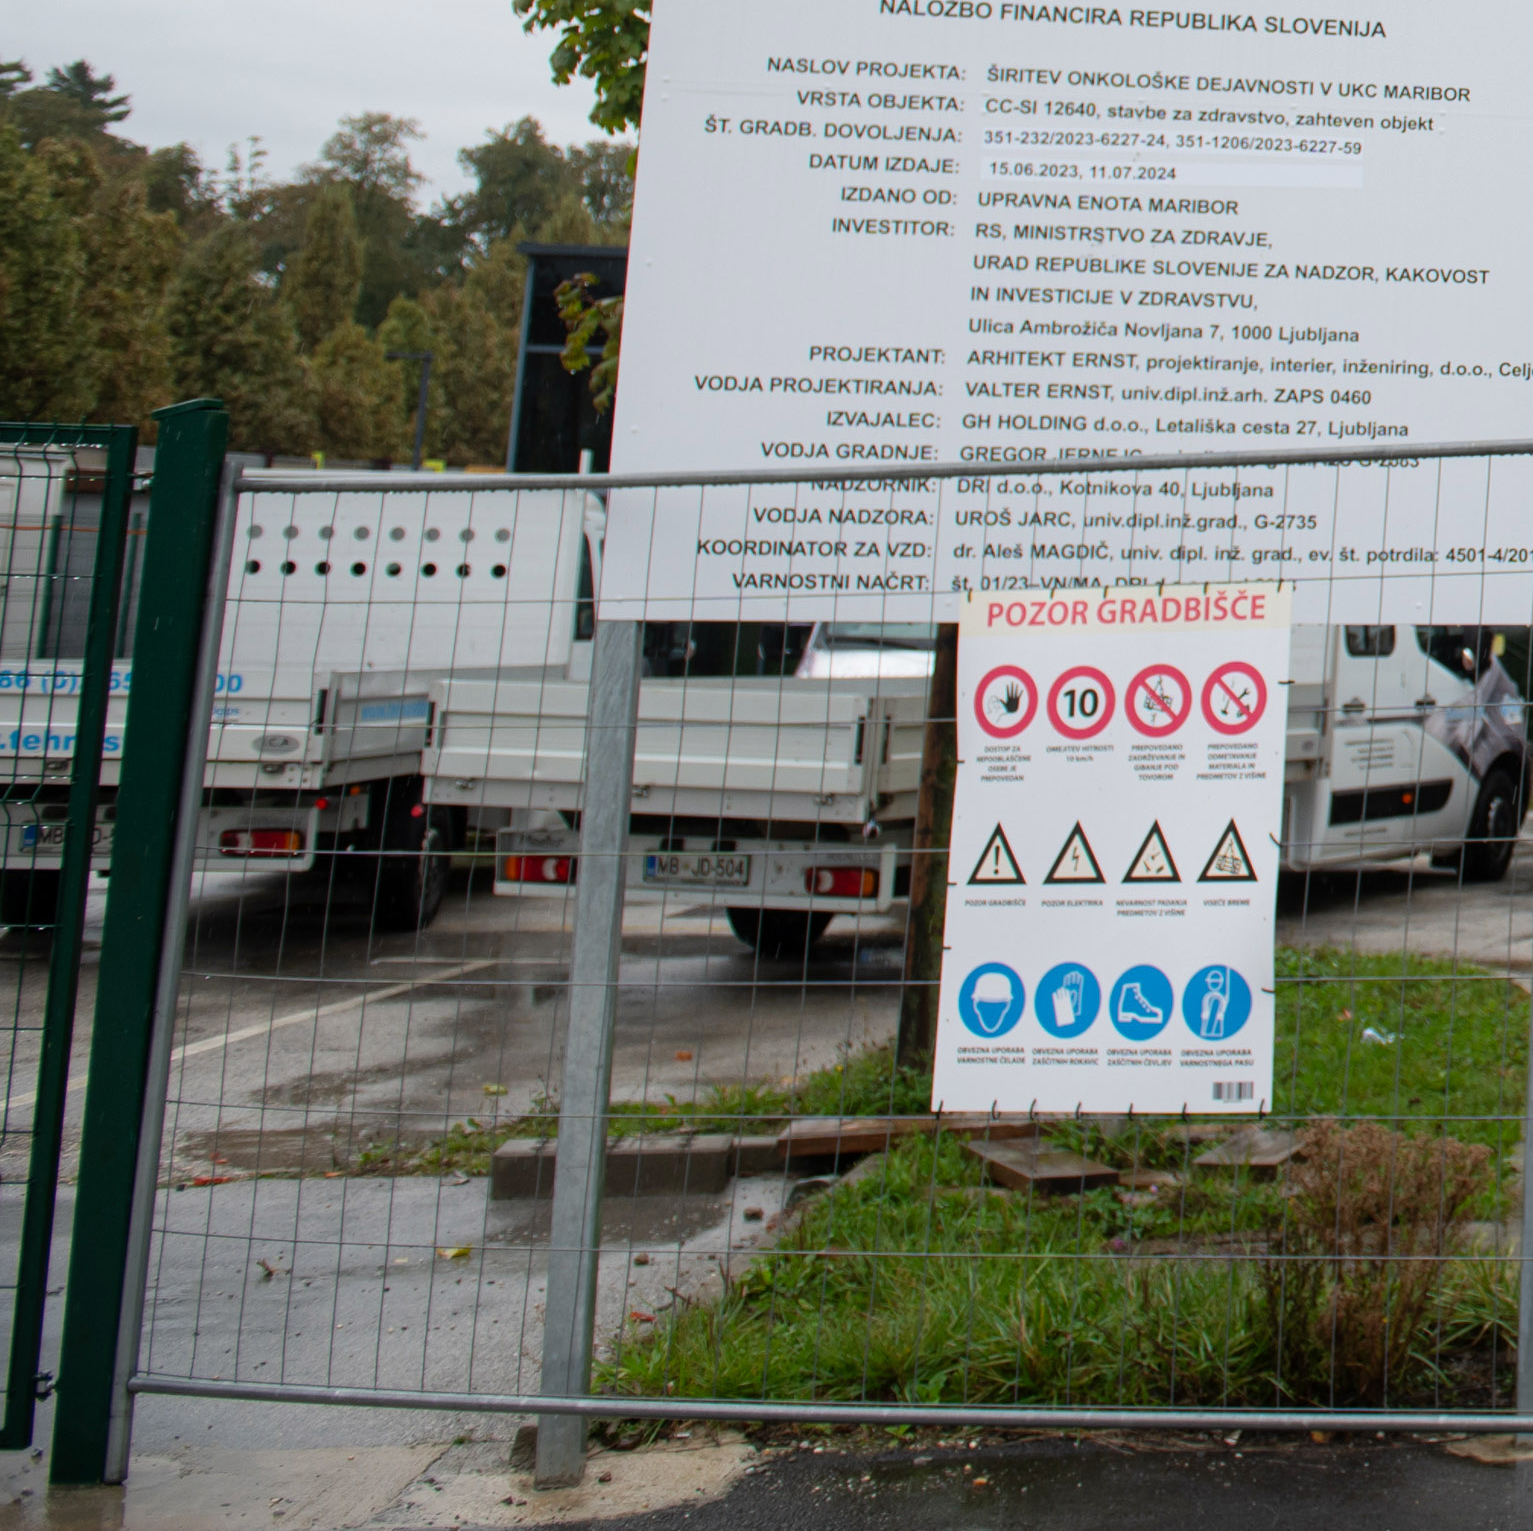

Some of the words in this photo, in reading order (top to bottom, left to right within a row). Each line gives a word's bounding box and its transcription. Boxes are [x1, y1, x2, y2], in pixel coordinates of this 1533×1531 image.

[999, 3, 1122, 25] FINANCIRA
[1128, 9, 1257, 32] REPUBLIKA
[1263, 15, 1386, 38] SLOVENIJA
[766, 57, 850, 75] NASLOV
[854, 61, 965, 80] PROJEKTA:
[986, 63, 1062, 85] ŠIRITEV
[1066, 70, 1189, 90] ONKOLOŠKE
[1195, 76, 1314, 95] DEJAVNOSTI
[1319, 81, 1332, 96] V
[1337, 82, 1377, 98] UKC
[1383, 84, 1470, 102] MARIBOR
[796, 90, 861, 107] VRSTA
[866, 93, 964, 111] OBJEKTA:
[984, 97, 1037, 114] CC-SI
[1044, 101, 1100, 119] 12640,
[1106, 105, 1167, 120] stavbe
[1171, 109, 1192, 121] za
[1197, 107, 1289, 126] zdravstvo,
[1295, 112, 1374, 128] zahteven
[1379, 115, 1434, 134] objekt
[703, 114, 731, 134] ŠT.
[738, 119, 816, 137] GRADB.
[822, 122, 962, 142] DOVOLJENJA:
[983, 130, 1169, 149] 351-232/2023-6227-24,
[1175, 134, 1362, 155] 351-1206/2023-6227-59
[808, 153, 879, 171] DATUM
[884, 156, 959, 174] IZDAJE:
[989, 161, 1082, 179] 15.06.2023,
[1089, 165, 1176, 180] 11.07.2024
[840, 186, 917, 204] IZDANO
[921, 189, 956, 205] OD:
[977, 191, 1072, 209] UPRAVNA
[1076, 195, 1143, 212] ENOTA
[1147, 197, 1239, 215] MARIBOR
[831, 217, 954, 236] INVESTITOR:
[974, 222, 1006, 241] RS,
[1012, 224, 1145, 243] MINISTRSTVO
[1149, 228, 1176, 244] ZA
[1179, 229, 1272, 248] ZDRAVJE,
[972, 254, 1029, 271] URAD
[1034, 256, 1146, 275] REPUBLIKE
[1151, 259, 1258, 278] SLOVENIJE
[1263, 263, 1289, 278] ZA
[1294, 264, 1378, 283] NADZOR,
[1385, 267, 1490, 284] KAKOVOST
[970, 285, 989, 301] IN
[995, 286, 1112, 305] INVESTICIJE
[1119, 290, 1133, 305] V
[1137, 290, 1257, 311] ZDRAVSTVU,
[967, 317, 1014, 334] Ulica
[1018, 319, 1118, 336] Ambrožiča
[1123, 321, 1203, 342] Novljana
[1209, 324, 1224, 341] 7,
[1231, 324, 1272, 340] 1000
[1277, 325, 1359, 346] Ljubljana
[808, 345, 945, 364] PROJEKTANT:
[966, 349, 1066, 367] ARHITEKT
[1071, 351, 1139, 370] ERNST,
[1145, 355, 1263, 375] projektiranje,
[1270, 357, 1336, 375] interier,
[1342, 358, 1433, 379] inženiring,
[1439, 360, 1492, 378] d.o.o.,
[693, 374, 763, 392] VODJA
[768, 377, 942, 396] PROJEKTIRANJA:
[964, 381, 1040, 398] VALTER
[1046, 383, 1114, 402] ERNST,
[1120, 385, 1267, 405] univ.dipl.inž.arh.
[1273, 388, 1324, 404] ZAPS
[1329, 389, 1372, 405] 0460
[825, 410, 940, 428] IZVAJALEC:
[960, 413, 991, 430] GH
[997, 414, 1087, 431] HOLDING
[1092, 416, 1148, 434] d.o.o.,
[1155, 417, 1236, 434] Letališka
[1241, 421, 1290, 435] cesta
[1295, 420, 1321, 436] 27,
[1327, 421, 1408, 440] Ljubljana
[760, 441, 829, 458] VODJA
[834, 443, 938, 460] GRADNJE:
[957, 479, 989, 493] DRI
[997, 480, 1053, 496] d.o.o.,
[1060, 480, 1151, 496] Kotnikova
[1159, 482, 1185, 498] 40,
[1192, 481, 1274, 500] Ljubljana
[753, 508, 822, 525] VODJA
[827, 508, 933, 526] NADZORA:
[954, 507, 1012, 526] UROŠ
[1017, 509, 1075, 529] JARC,
[1083, 510, 1248, 532] univ.dipl.inž.grad.,
[1254, 514, 1318, 530] G-2735
[696, 540, 847, 557] KOORDINATOR
[853, 541, 880, 558] ZA
[885, 540, 931, 558] VZD:
[951, 543, 976, 559] dr.
[981, 543, 1023, 560] Aleš
[1029, 540, 1113, 563] MAGDIČ,
[1119, 545, 1162, 561] univ.
[1169, 545, 1207, 566] dipl.
[1214, 545, 1244, 562] inž.
[1250, 545, 1302, 565] grad.,
[1307, 550, 1333, 565] ev.
[1339, 546, 1359, 563] št.
[1366, 546, 1438, 568] potrdila:
[732, 573, 849, 590] VARNOSTNI
[856, 571, 930, 591] NAČRT:
[987, 599, 1089, 627] POZOR
[1096, 594, 1265, 625] GRADBIŠČE
[1064, 689, 1099, 718] 10
